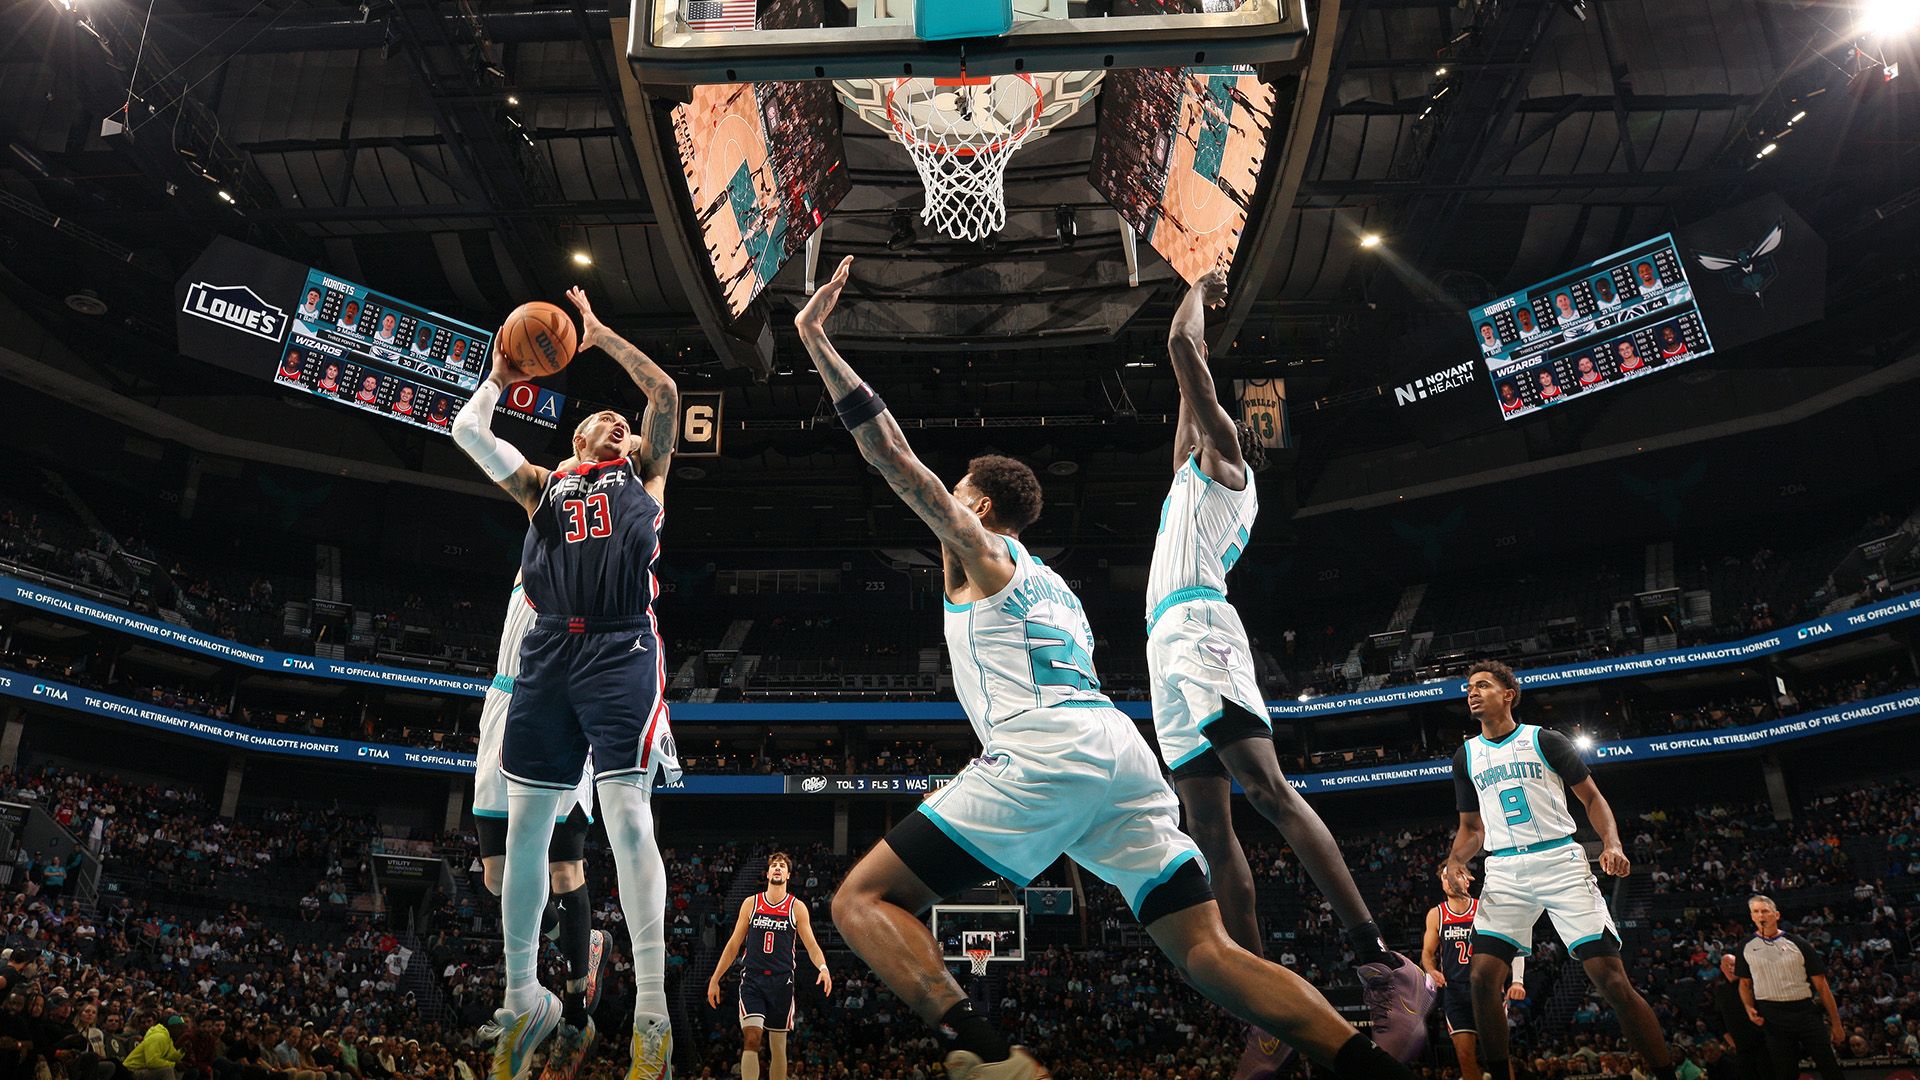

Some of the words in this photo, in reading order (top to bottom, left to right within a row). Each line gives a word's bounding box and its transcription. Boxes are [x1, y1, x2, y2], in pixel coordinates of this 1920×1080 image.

[322, 277, 355, 295] HORNETS
[1649, 281, 1686, 298] Washington
[196, 290, 277, 334] LOWE'S
[1484, 298, 1516, 316] HORNETS
[295, 336, 342, 357] WIZARDS
[403, 359, 411, 367] 30
[1425, 360, 1474, 385] NOVANT
[1497, 356, 1542, 377] WIZARDS
[1429, 372, 1474, 395] HEALTH
[1245, 398, 1277, 408] PHILLS
[507, 408, 526, 420] OFFICE
[534, 418, 557, 430] AMERICA
[684, 405, 713, 442] 6
[1251, 412, 1274, 439] 13
[563, 493, 612, 543] 33
[865, 581, 885, 591] 233
[1848, 614, 1866, 624] THE
[1868, 604, 1908, 619] OFFICIAL
[17, 588, 33, 599] THE
[36, 594, 72, 610] OFFICIAL
[74, 605, 124, 624] RETIREMENT
[125, 619, 158, 634] PARTNER
[160, 629, 171, 637] OF
[173, 632, 186, 642] THE
[188, 637, 230, 654] CHARLOTTE
[231, 649, 264, 662] HORNETS
[1808, 624, 1832, 635] TIAA
[294, 660, 314, 670] TIAA
[1524, 673, 1560, 683] OFFICIAL
[1562, 665, 1612, 678] RETIREMENT
[1615, 660, 1653, 671] PARTNER
[1654, 658, 1666, 666] OF
[1668, 656, 1686, 664] THE
[1688, 648, 1741, 661] CHARLOTTE
[1742, 638, 1780, 653] HORNETS
[347, 668, 380, 678] OFFICIAL
[382, 672, 428, 684] RETIREMENT
[429, 679, 461, 688] PARTNER
[475, 684, 488, 692] THE
[46, 687, 68, 700] TIAA
[1267, 705, 1303, 713] ETIREMENT
[1304, 701, 1336, 711] PARTNER
[1364, 693, 1406, 704] CHARLOTTE
[1408, 688, 1443, 698] HORNETS
[85, 697, 101, 707] THE
[103, 702, 138, 716] OFFICIAL
[140, 710, 188, 727] RETIREMENT
[190, 722, 222, 735] PARTNER
[224, 730, 234, 738] OF
[236, 732, 249, 742] THE
[251, 736, 298, 748] CHARLOTTE
[300, 742, 338, 752] HORNETS
[1670, 738, 1711, 749] OFFICIAL
[1714, 730, 1767, 744] RETIREMENT
[1770, 722, 1807, 736] PARTNER
[1809, 718, 1820, 727] OF
[1822, 714, 1840, 724] THE
[1842, 702, 1896, 720] CHARLOTTE
[369, 749, 389, 758] TIAA
[422, 756, 455, 765] OFFICIAL
[1608, 746, 1632, 756] TIAA
[837, 781, 854, 789] TOL
[858, 780, 864, 789] 3
[872, 781, 888, 789] FLS
[893, 780, 899, 789] 3
[906, 780, 927, 790] WAS
[1337, 775, 1370, 784] OFFICIAL
[1372, 770, 1417, 780] RETIREMENT
[1420, 766, 1452, 775] PARTNER
[1473, 762, 1542, 791] CHARLOTTE
[1499, 786, 1532, 826] 9
[753, 915, 788, 929] district
[1444, 926, 1471, 938] distr
[763, 931, 774, 953] 8
